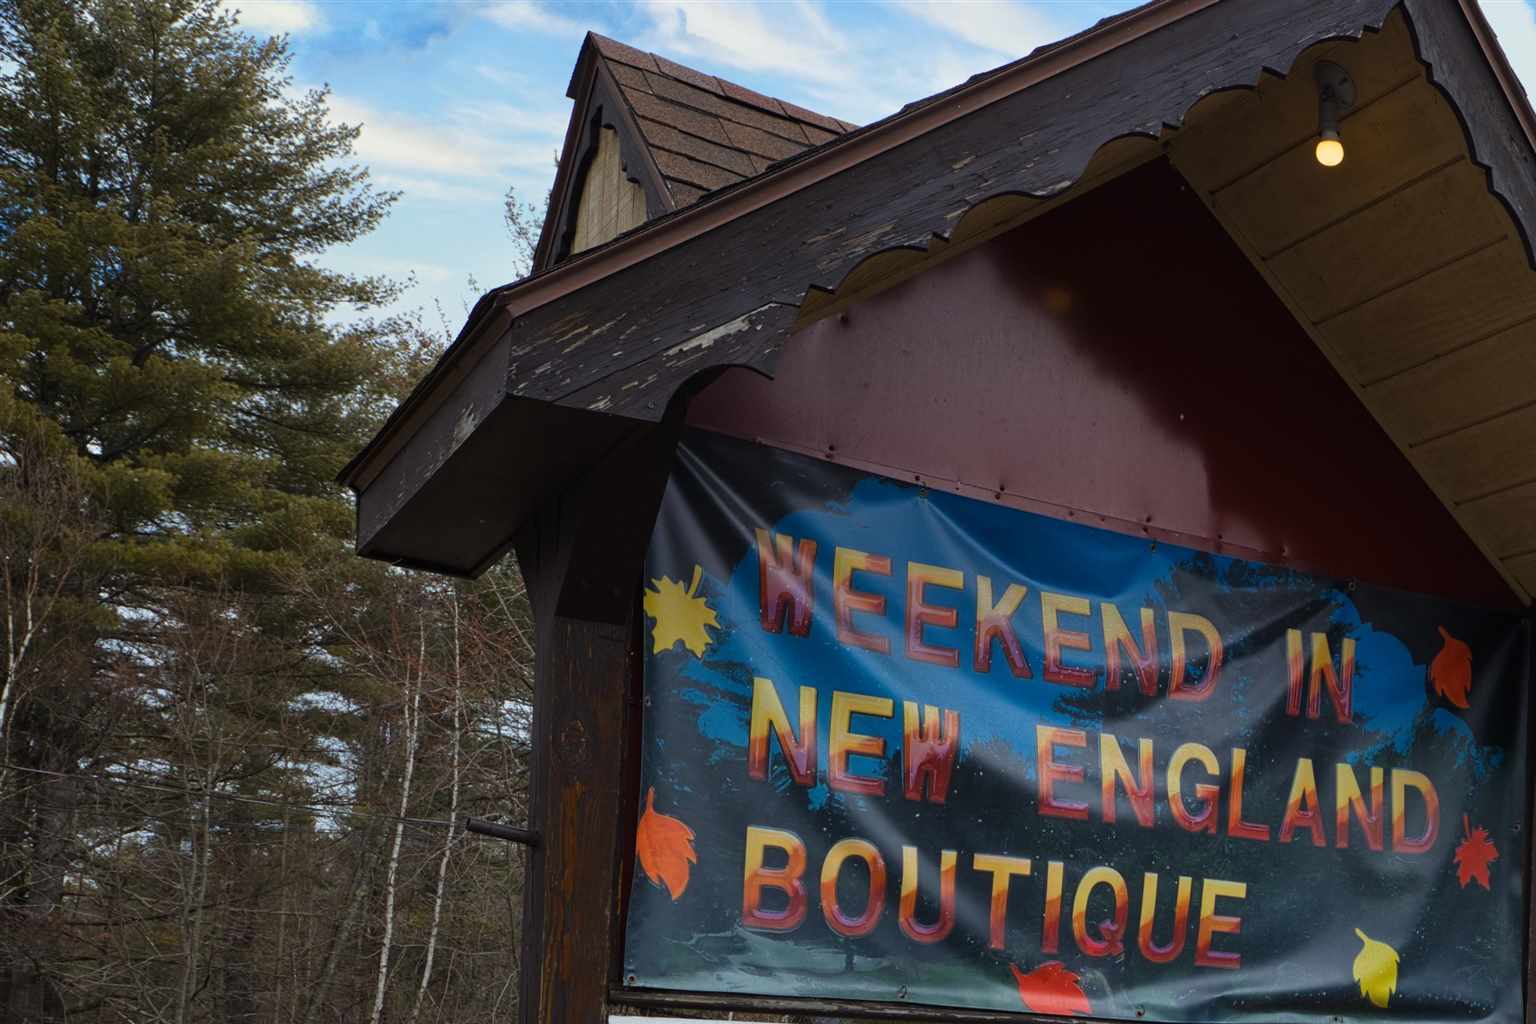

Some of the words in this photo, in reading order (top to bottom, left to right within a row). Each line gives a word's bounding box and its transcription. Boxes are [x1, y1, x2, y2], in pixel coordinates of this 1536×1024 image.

[755, 527, 1225, 702] WEEKEND
[1286, 627, 1356, 724] IN
[747, 677, 961, 804] NEW
[1036, 723, 1440, 855] ENGLAND
[741, 825, 1248, 970] BOUTIQUE
